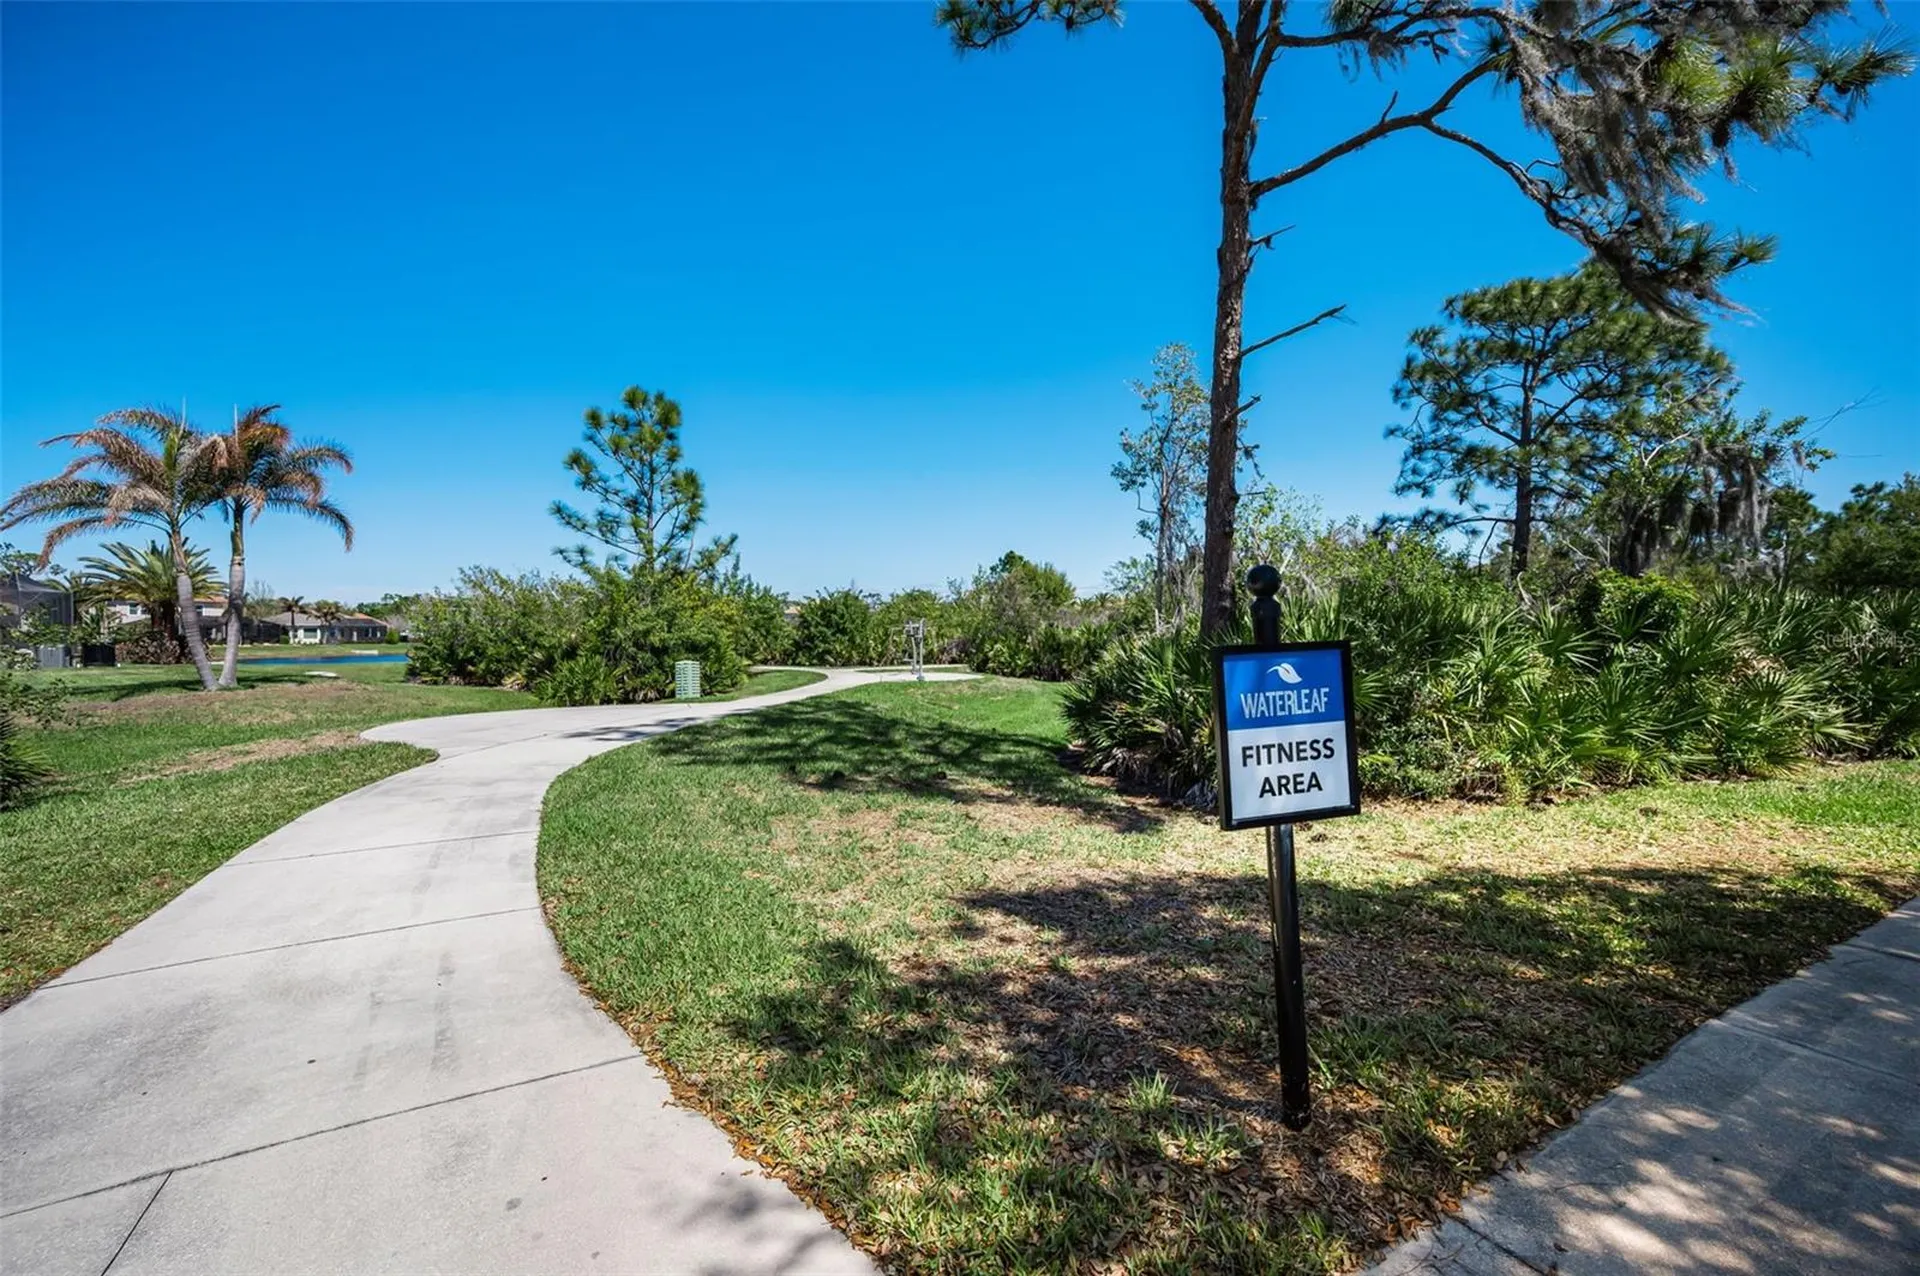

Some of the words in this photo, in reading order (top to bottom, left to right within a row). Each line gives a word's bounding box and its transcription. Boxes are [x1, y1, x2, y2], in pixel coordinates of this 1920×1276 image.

[1240, 687, 1330, 719] WATERLEAF
[1241, 738, 1335, 767] FITNESS
[1259, 771, 1323, 798] AREA
